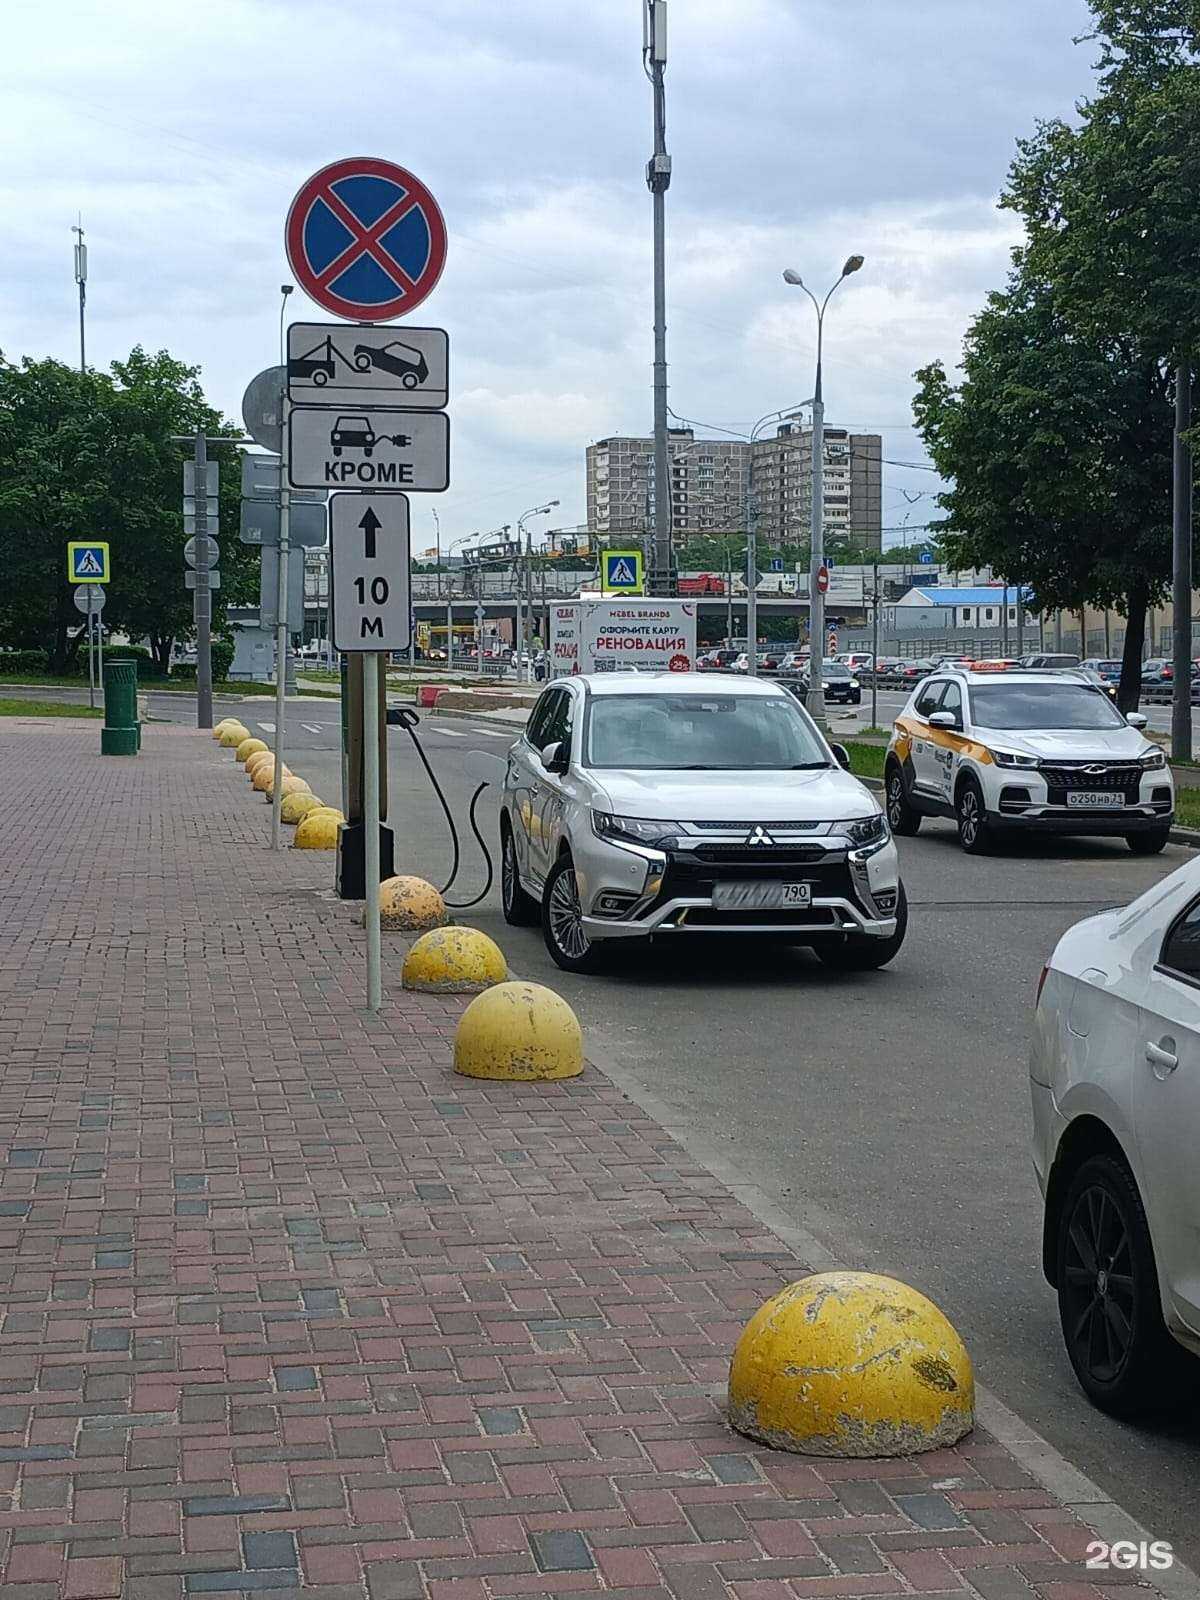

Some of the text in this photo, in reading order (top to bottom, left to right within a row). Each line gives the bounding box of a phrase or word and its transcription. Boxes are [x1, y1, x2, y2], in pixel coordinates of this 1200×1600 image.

[324, 461, 414, 483] КРОМЕ
[353, 576, 389, 605] 10
[360, 617, 384, 638] М
[599, 626, 679, 636] ОФОРМИТЕ КАРТУ
[596, 637, 686, 651] РЕНОВАЦИЯ
